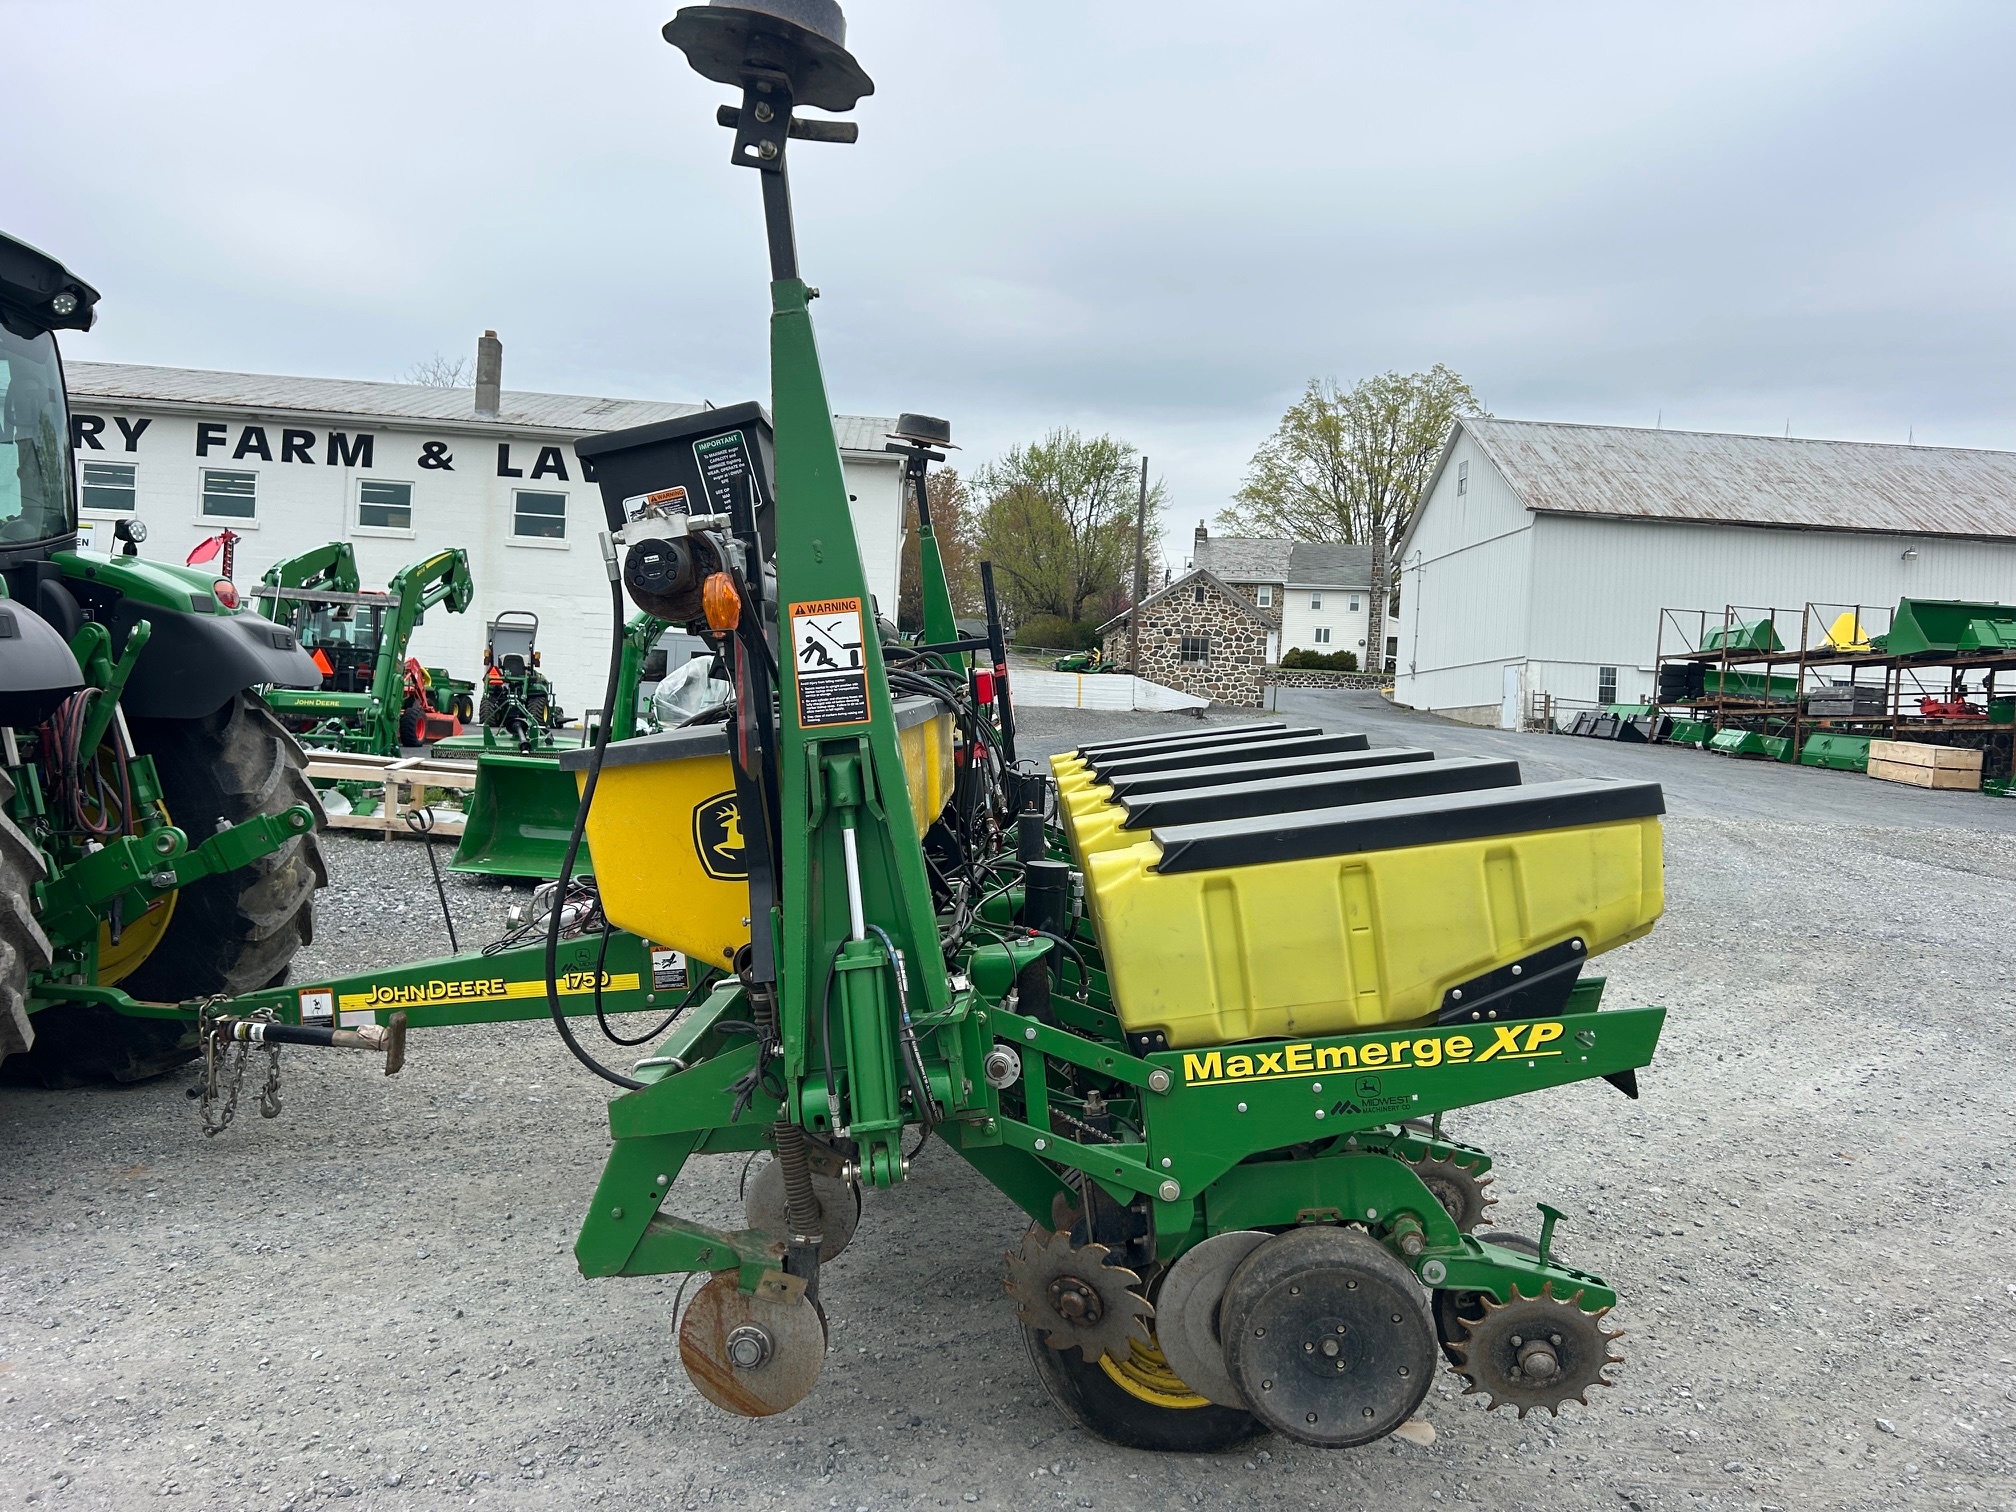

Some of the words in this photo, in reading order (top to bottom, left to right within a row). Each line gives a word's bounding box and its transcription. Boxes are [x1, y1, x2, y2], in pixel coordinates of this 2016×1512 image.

[195, 422, 375, 469] FARM
[417, 441, 456, 471] &
[698, 434, 738, 451] IMPORTANT
[657, 489, 685, 501] WARNING
[806, 600, 857, 614] WARNING
[294, 698, 315, 706] JOHN
[315, 699, 340, 707] DEERE
[365, 984, 427, 1004] JOHN
[428, 978, 505, 999] DEERE
[1182, 1035, 1475, 1081] MaxEmerge
[1473, 1022, 1566, 1063] XP
[1361, 1095, 1411, 1107] MIDWEST
[1362, 1105, 1400, 1114] MACHINERY
[1401, 1103, 1411, 1111] CO
